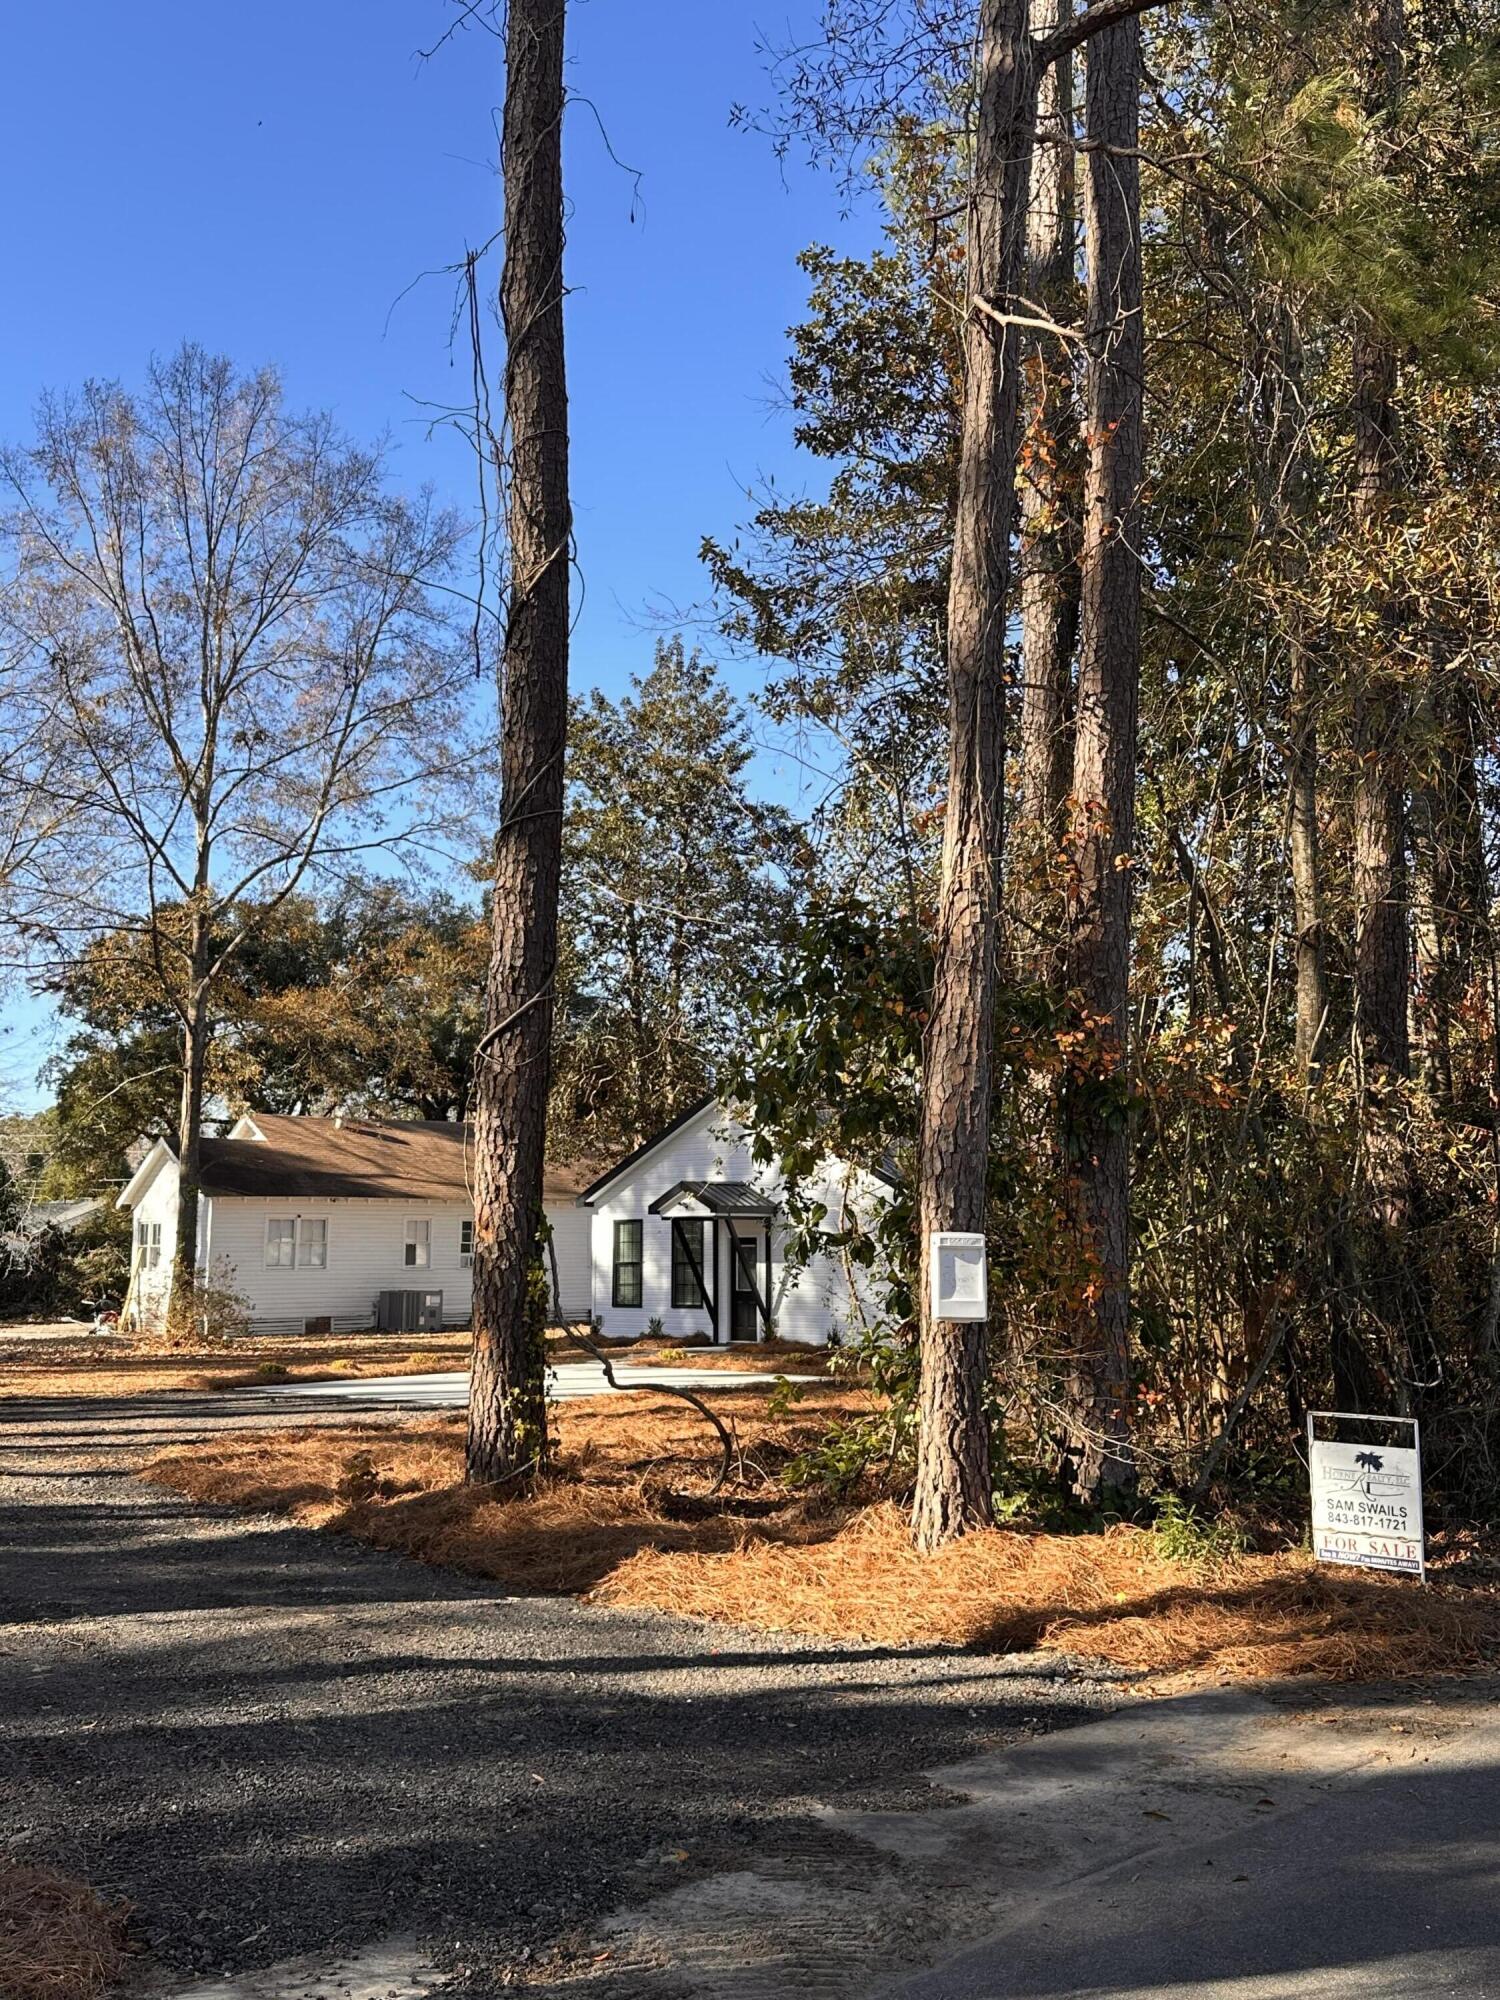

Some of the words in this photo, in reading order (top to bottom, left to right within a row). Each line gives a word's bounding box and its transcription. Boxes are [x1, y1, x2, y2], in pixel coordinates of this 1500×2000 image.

[1327, 1499, 1354, 1512] SAM
[1359, 1502, 1407, 1517] SWAILS
[1328, 1512, 1407, 1531] 843-817-1721
[1324, 1535, 1358, 1552] FOR
[1369, 1541, 1417, 1559] SALE
